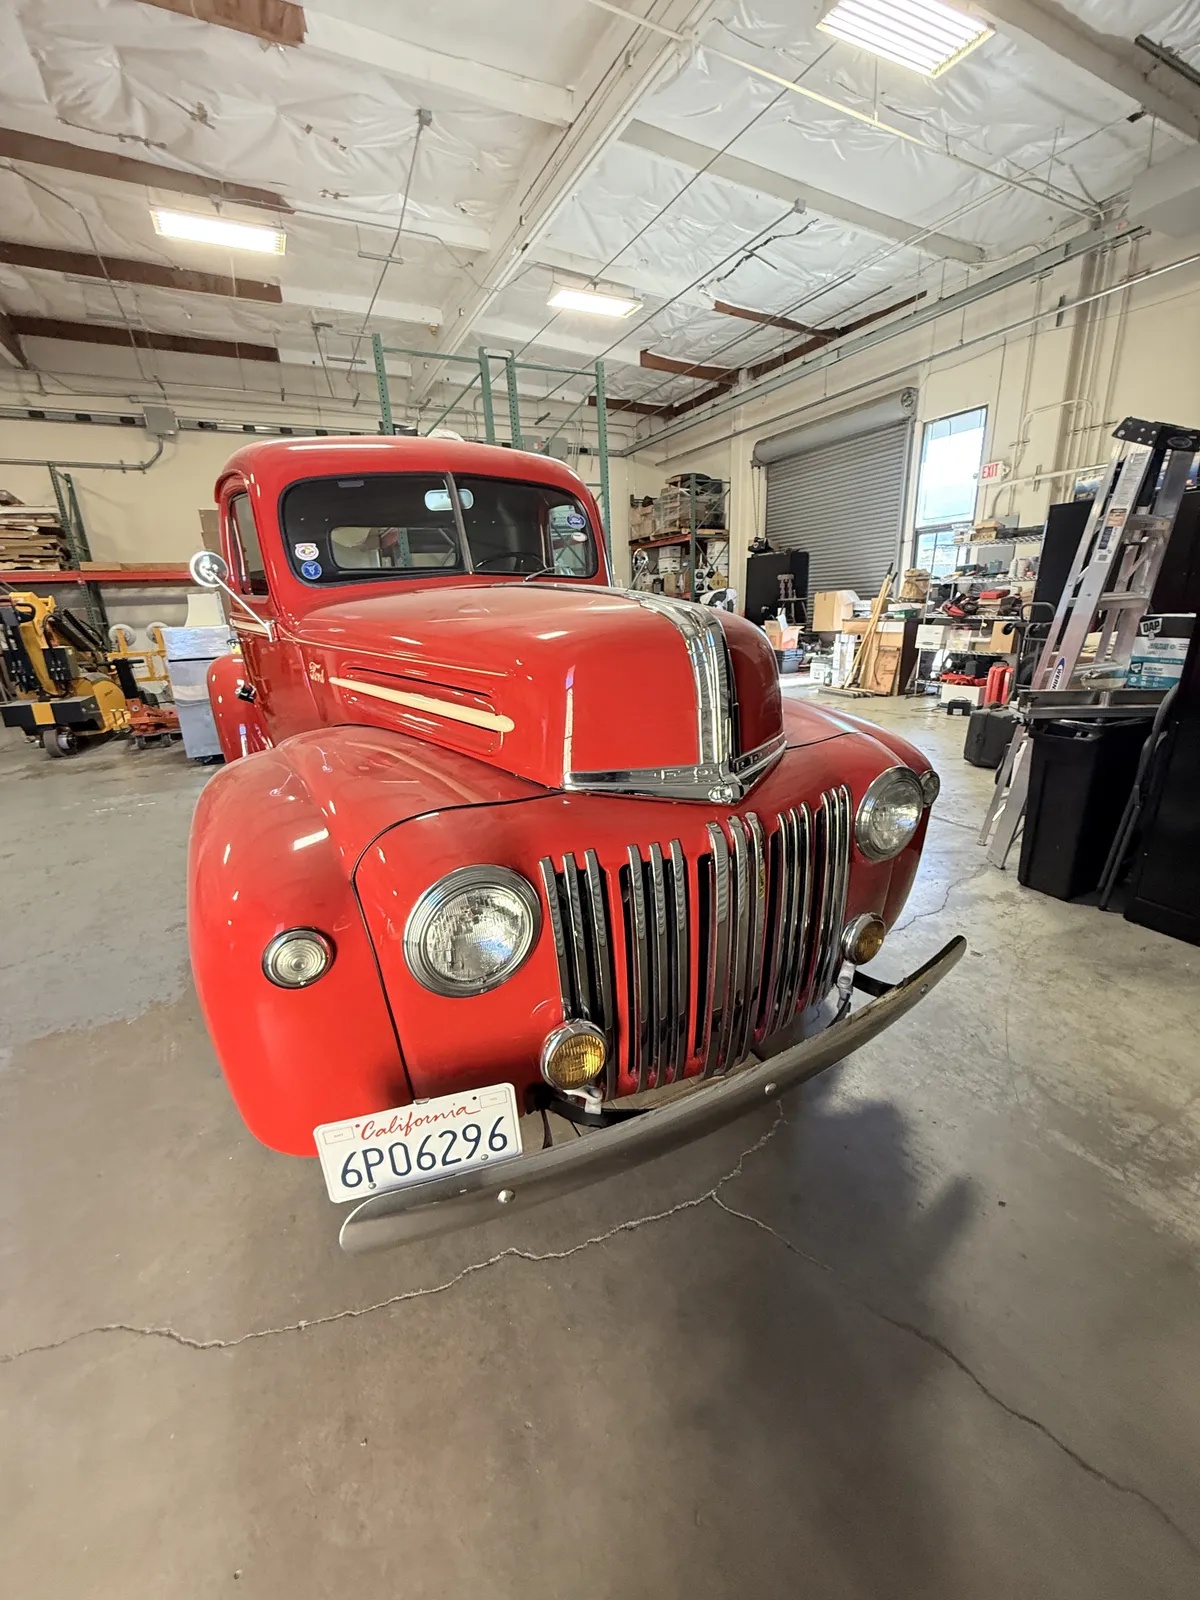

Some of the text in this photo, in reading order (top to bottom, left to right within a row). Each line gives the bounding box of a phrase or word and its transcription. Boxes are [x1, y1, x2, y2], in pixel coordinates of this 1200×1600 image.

[982, 463, 999, 479] EXIT
[1142, 620, 1160, 633] DAP
[309, 661, 325, 684] Ford
[1051, 668, 1062, 690] WERN
[360, 1103, 481, 1141] California
[341, 1116, 508, 1188] 6P06296
